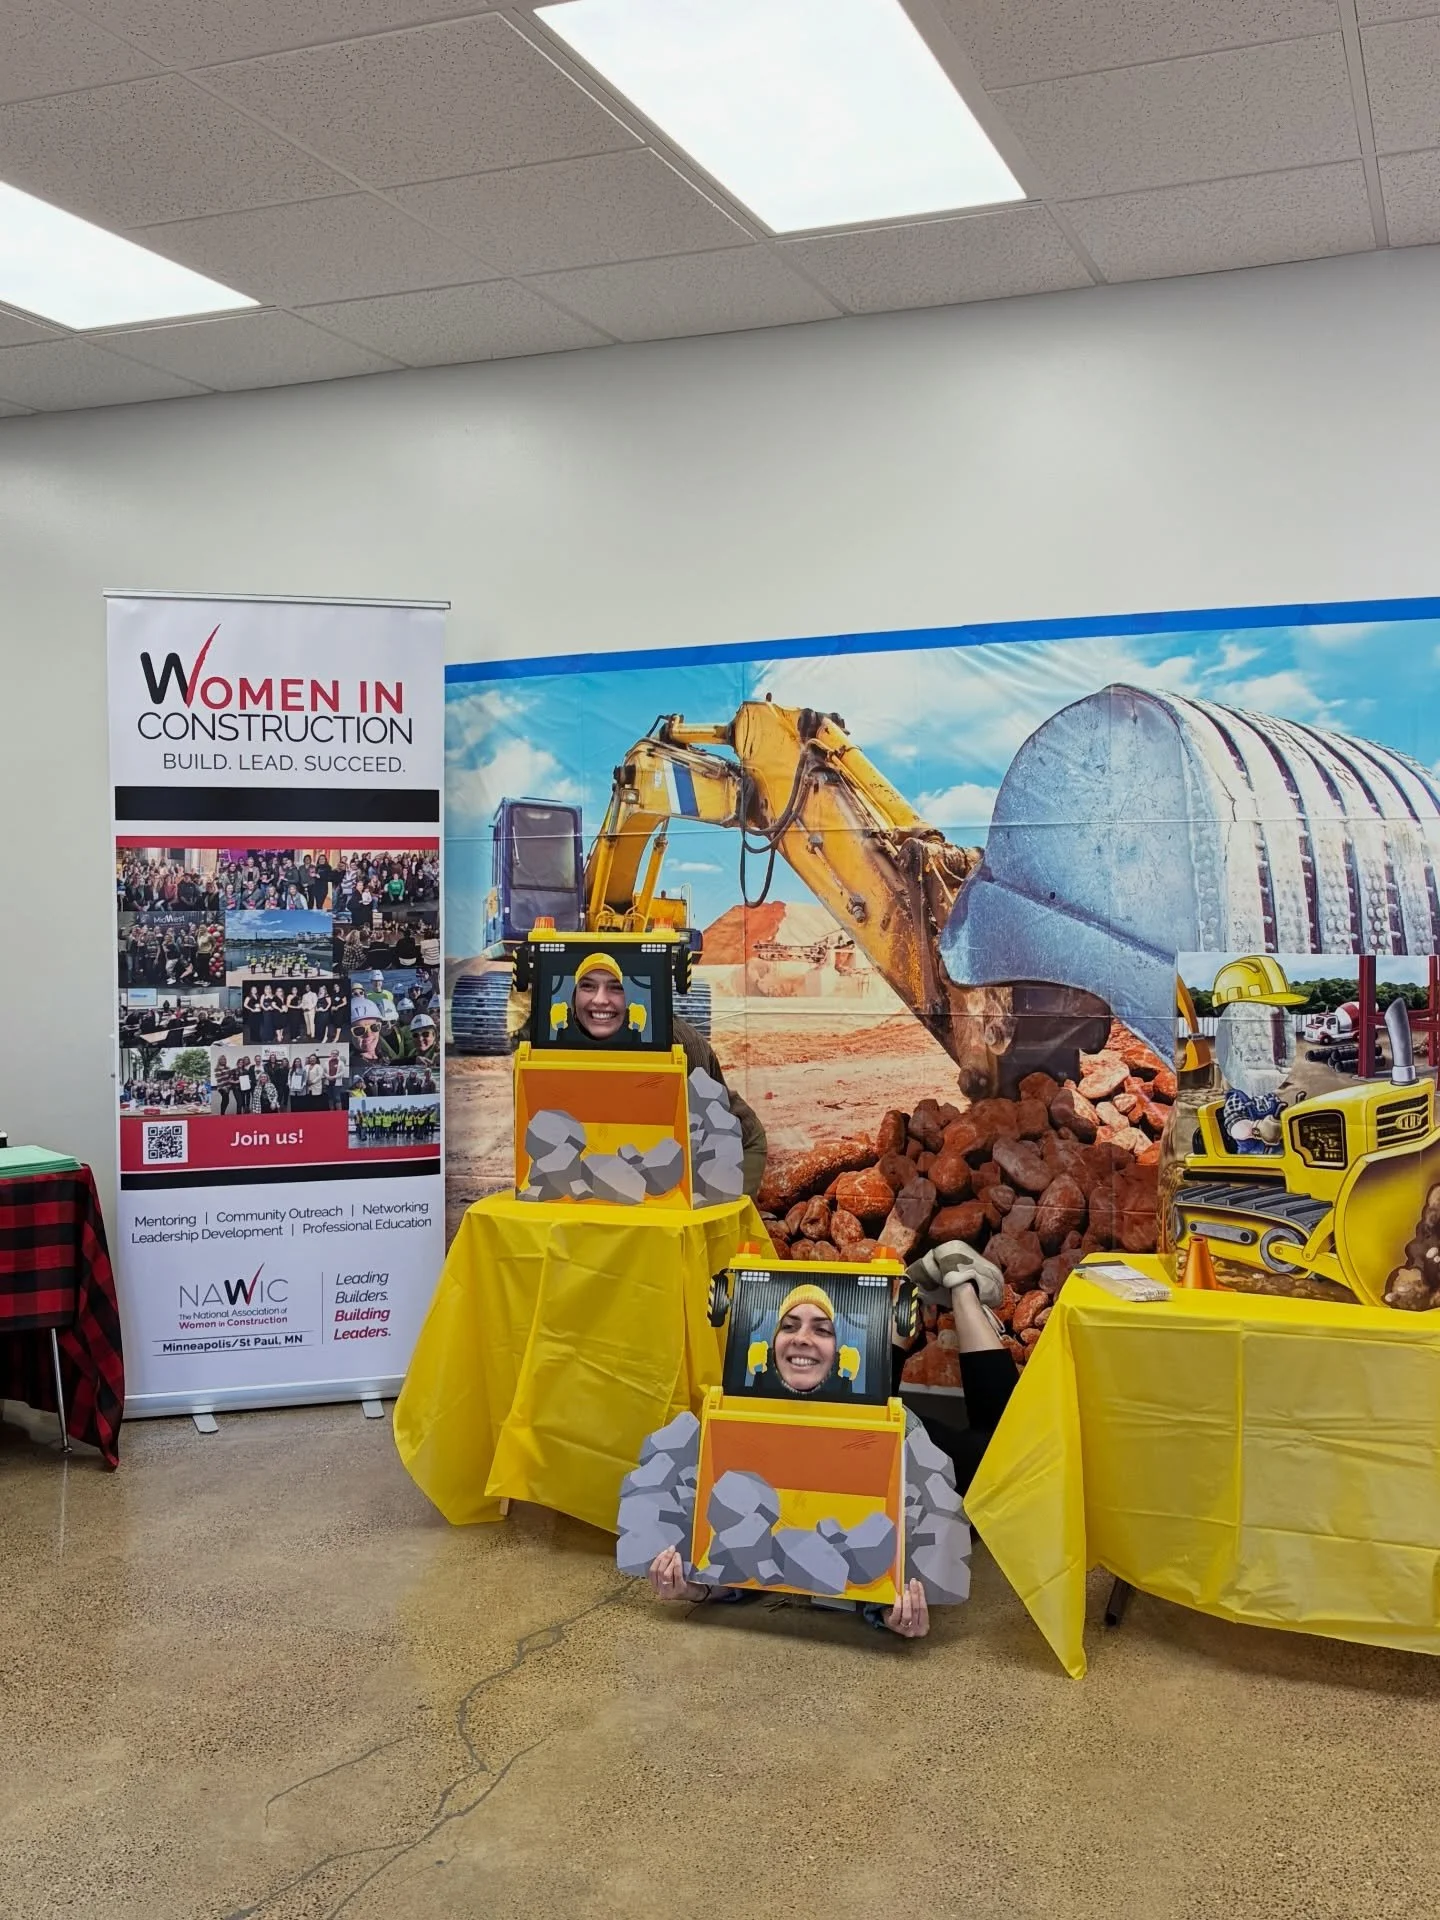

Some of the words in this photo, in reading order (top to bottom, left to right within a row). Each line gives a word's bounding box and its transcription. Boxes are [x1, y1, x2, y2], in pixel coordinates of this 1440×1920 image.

[140, 623, 340, 713] WOMEN
[360, 680, 403, 714] IN
[137, 712, 413, 745] CONSTRUCTION
[163, 753, 232, 770] BUILD.
[239, 754, 298, 771] LEAD.
[304, 755, 406, 773] SUCCEED.
[230, 1130, 270, 1147] Join
[275, 1129, 304, 1145] us!
[134, 1214, 197, 1228] Mentoring
[216, 1209, 286, 1223] Community
[288, 1205, 343, 1219] Outreach
[362, 1202, 429, 1215] Networking
[131, 1229, 199, 1244] Leadership
[201, 1225, 283, 1240] Development
[302, 1219, 372, 1234] Professional
[375, 1216, 432, 1230] Education
[179, 1262, 289, 1308] NAWIC
[336, 1271, 390, 1286] Leading
[335, 1290, 389, 1304] Builders.
[179, 1313, 192, 1321] The
[193, 1309, 229, 1320] National
[231, 1306, 279, 1317] Association
[179, 1320, 216, 1330] Women
[218, 1320, 225, 1328] in
[226, 1315, 288, 1327] Construction
[334, 1307, 391, 1322] Building
[333, 1326, 392, 1341] Leaders.
[162, 1338, 251, 1353] Minneapolis/St
[284, 1334, 303, 1345] MN
